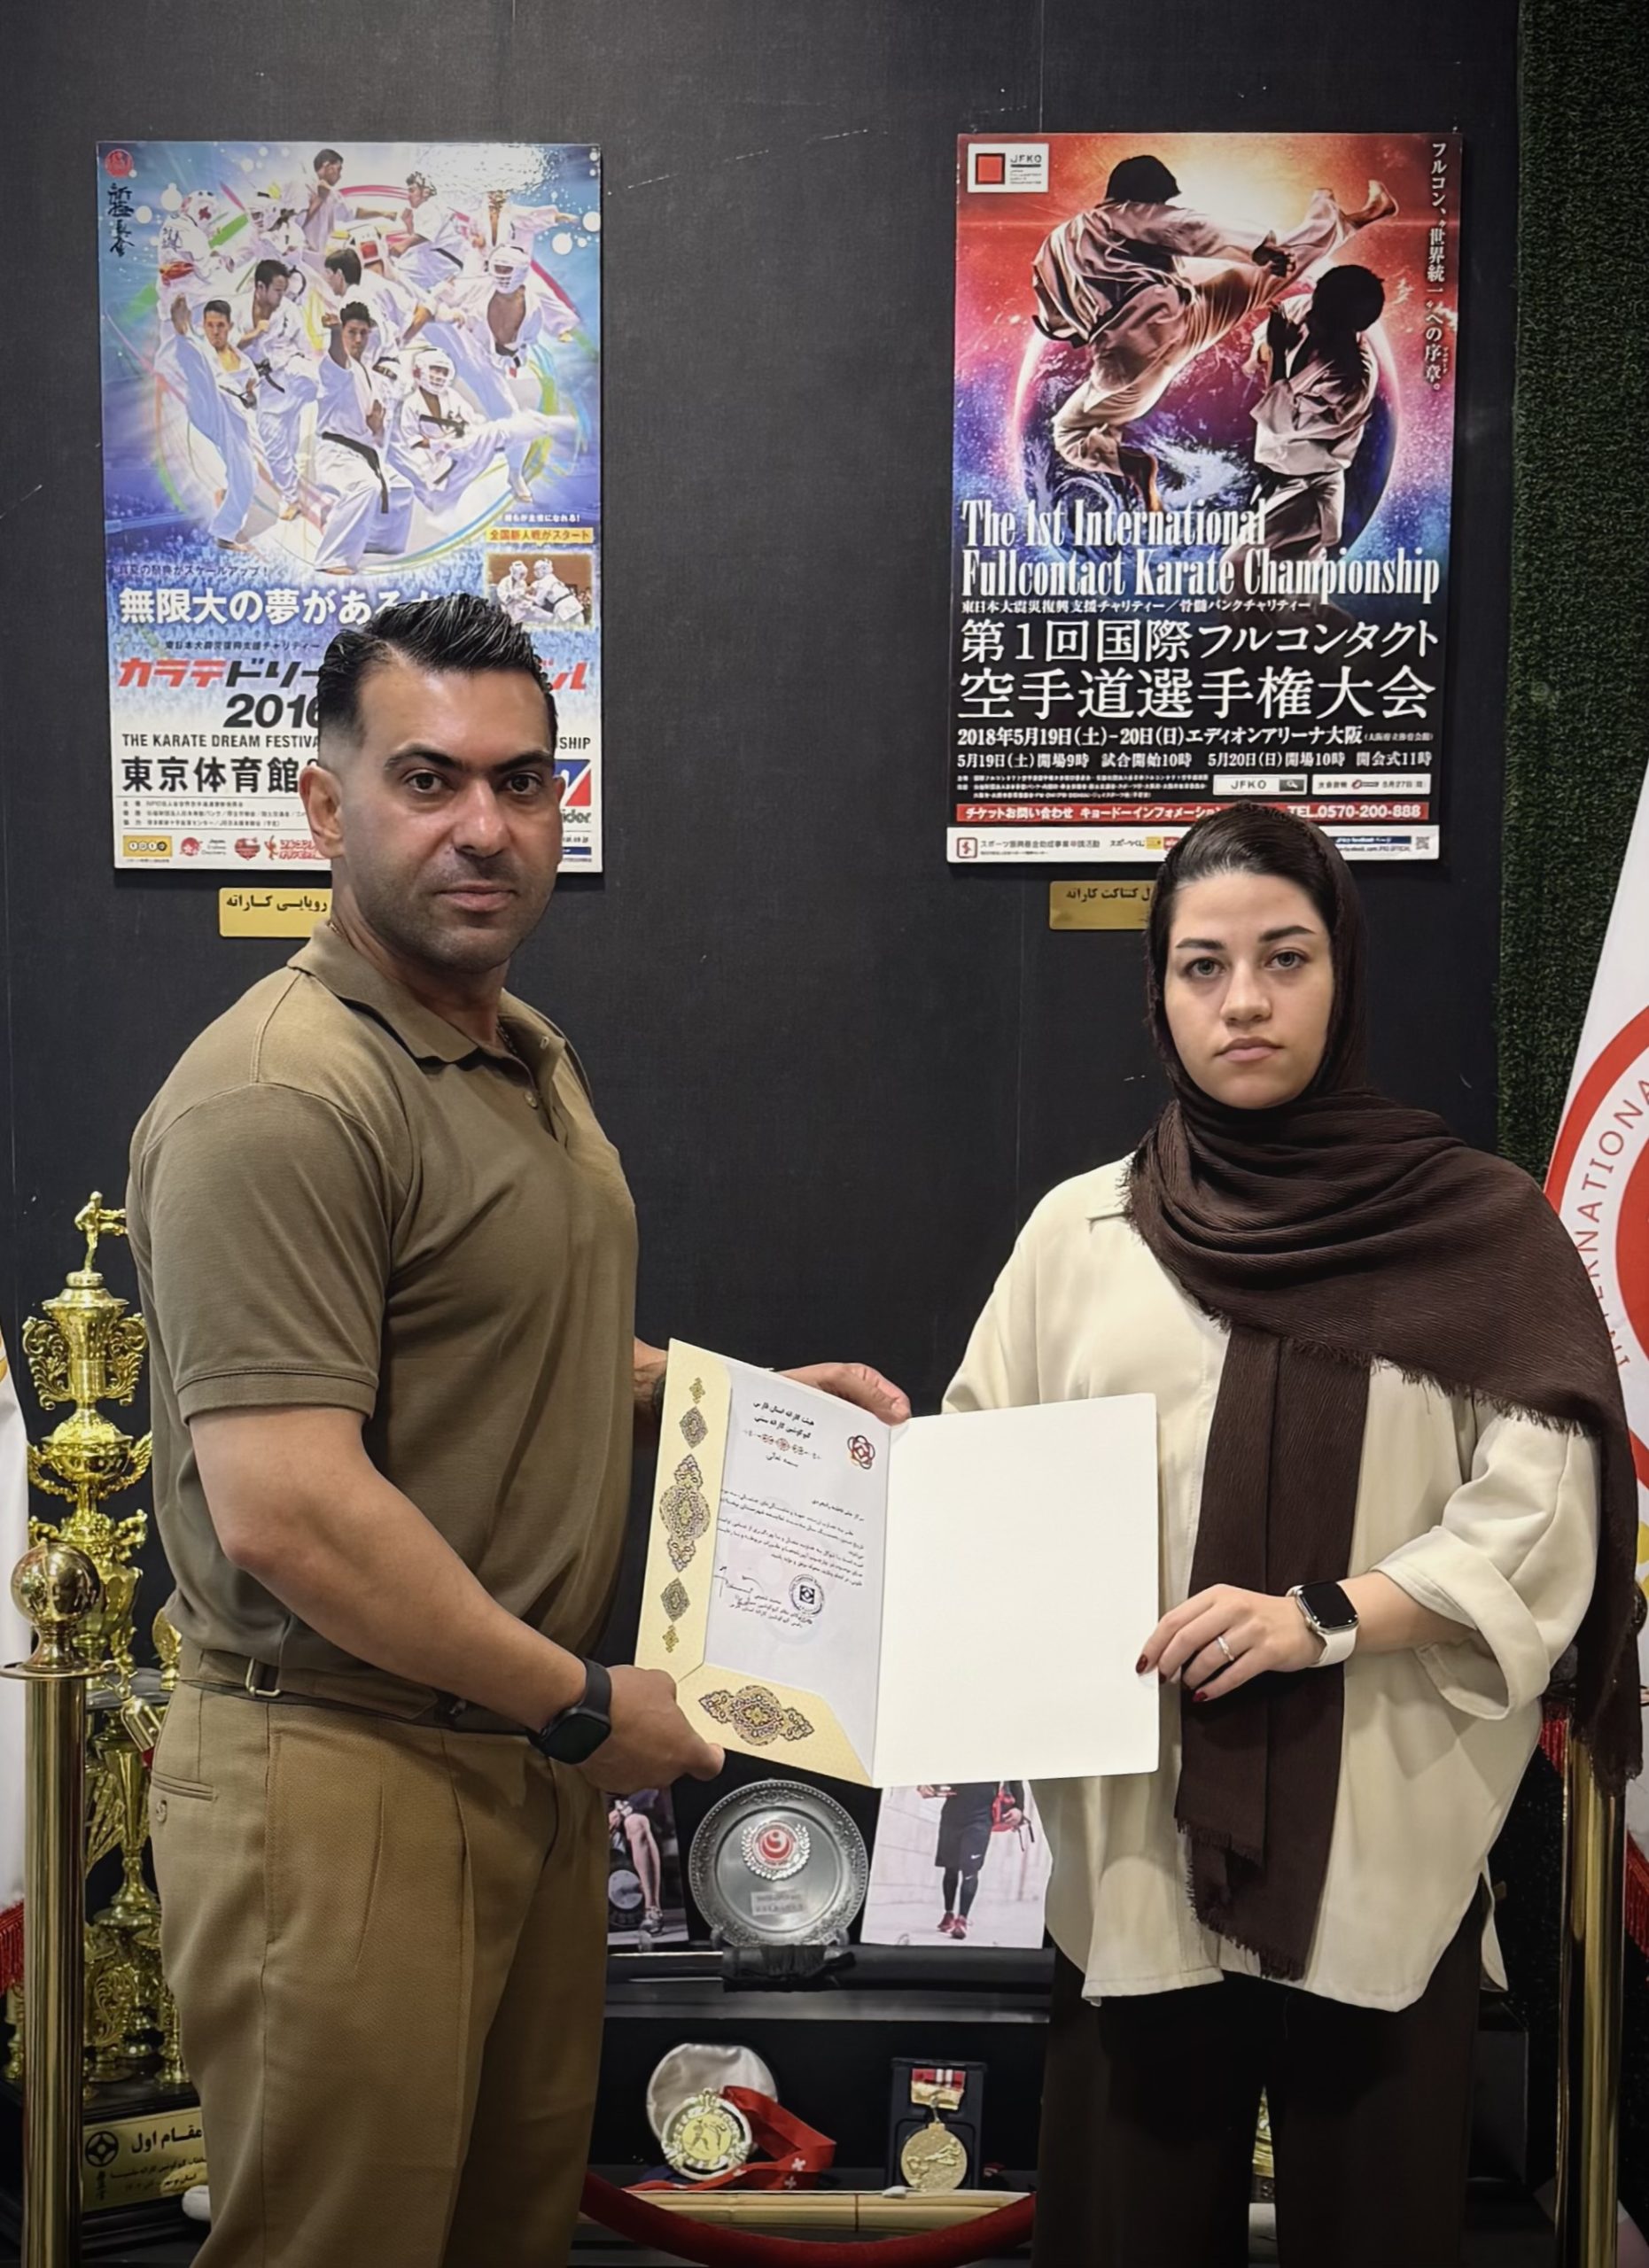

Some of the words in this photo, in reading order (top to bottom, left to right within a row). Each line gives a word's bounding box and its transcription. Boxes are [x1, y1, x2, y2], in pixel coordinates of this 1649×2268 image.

[961, 499, 1016, 547] The
[1025, 499, 1065, 546] 1st
[1074, 497, 1266, 546] International
[961, 548, 1126, 596] Fullcontact
[1134, 548, 1235, 596] Karate
[1244, 547, 1440, 605] Championship
[961, 618, 1439, 664] 第1回国際フルコンタクト
[957, 664, 1436, 720] 空手道選手権大会
[122, 734, 148, 747] THE
[153, 734, 206, 748] KARATE
[212, 734, 261, 748] DREAM
[121, 756, 299, 794] 東京体育館
[1231, 780, 1267, 789] JFKO
[226, 895, 273, 911] کاراته
[1066, 888, 1098, 903] کاراته
[131, 2130, 158, 2154] اول
